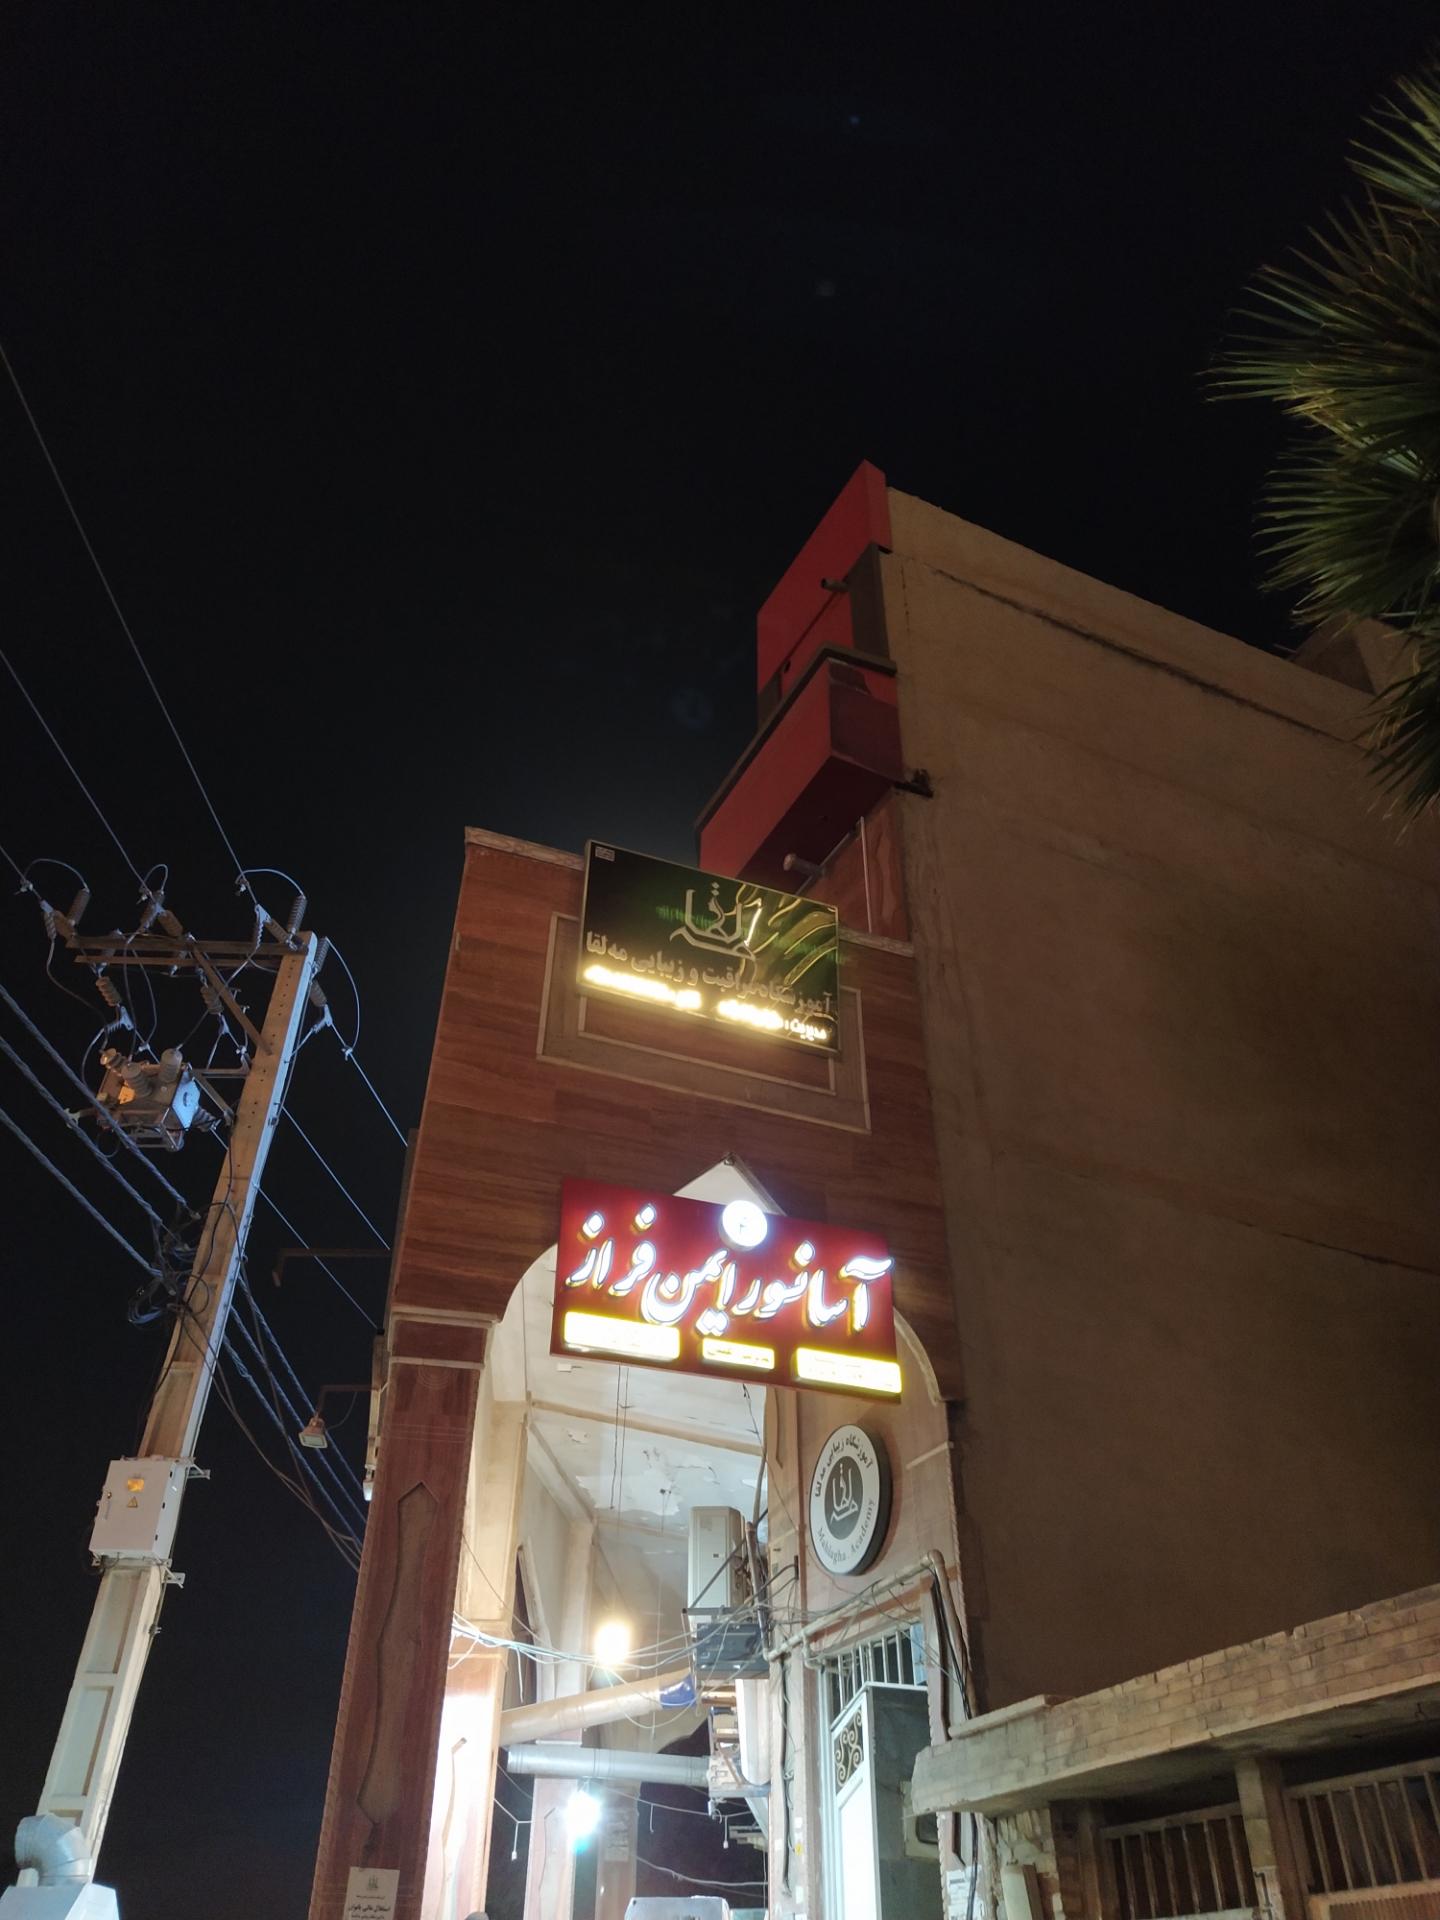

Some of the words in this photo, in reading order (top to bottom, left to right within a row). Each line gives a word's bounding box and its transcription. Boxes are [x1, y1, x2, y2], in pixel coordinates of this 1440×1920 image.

[631, 950, 685, 983] زیبایی
[687, 967, 699, 986] و
[702, 966, 757, 999] مراقبت
[757, 978, 832, 1014] آموزشگاه
[565, 1202, 656, 1297] فراز
[639, 1248, 737, 1337] ایمن
[731, 1240, 894, 1333] آسانسور
[845, 1433, 873, 1468] آموزشگاه
[850, 1500, 876, 1553] Academy
